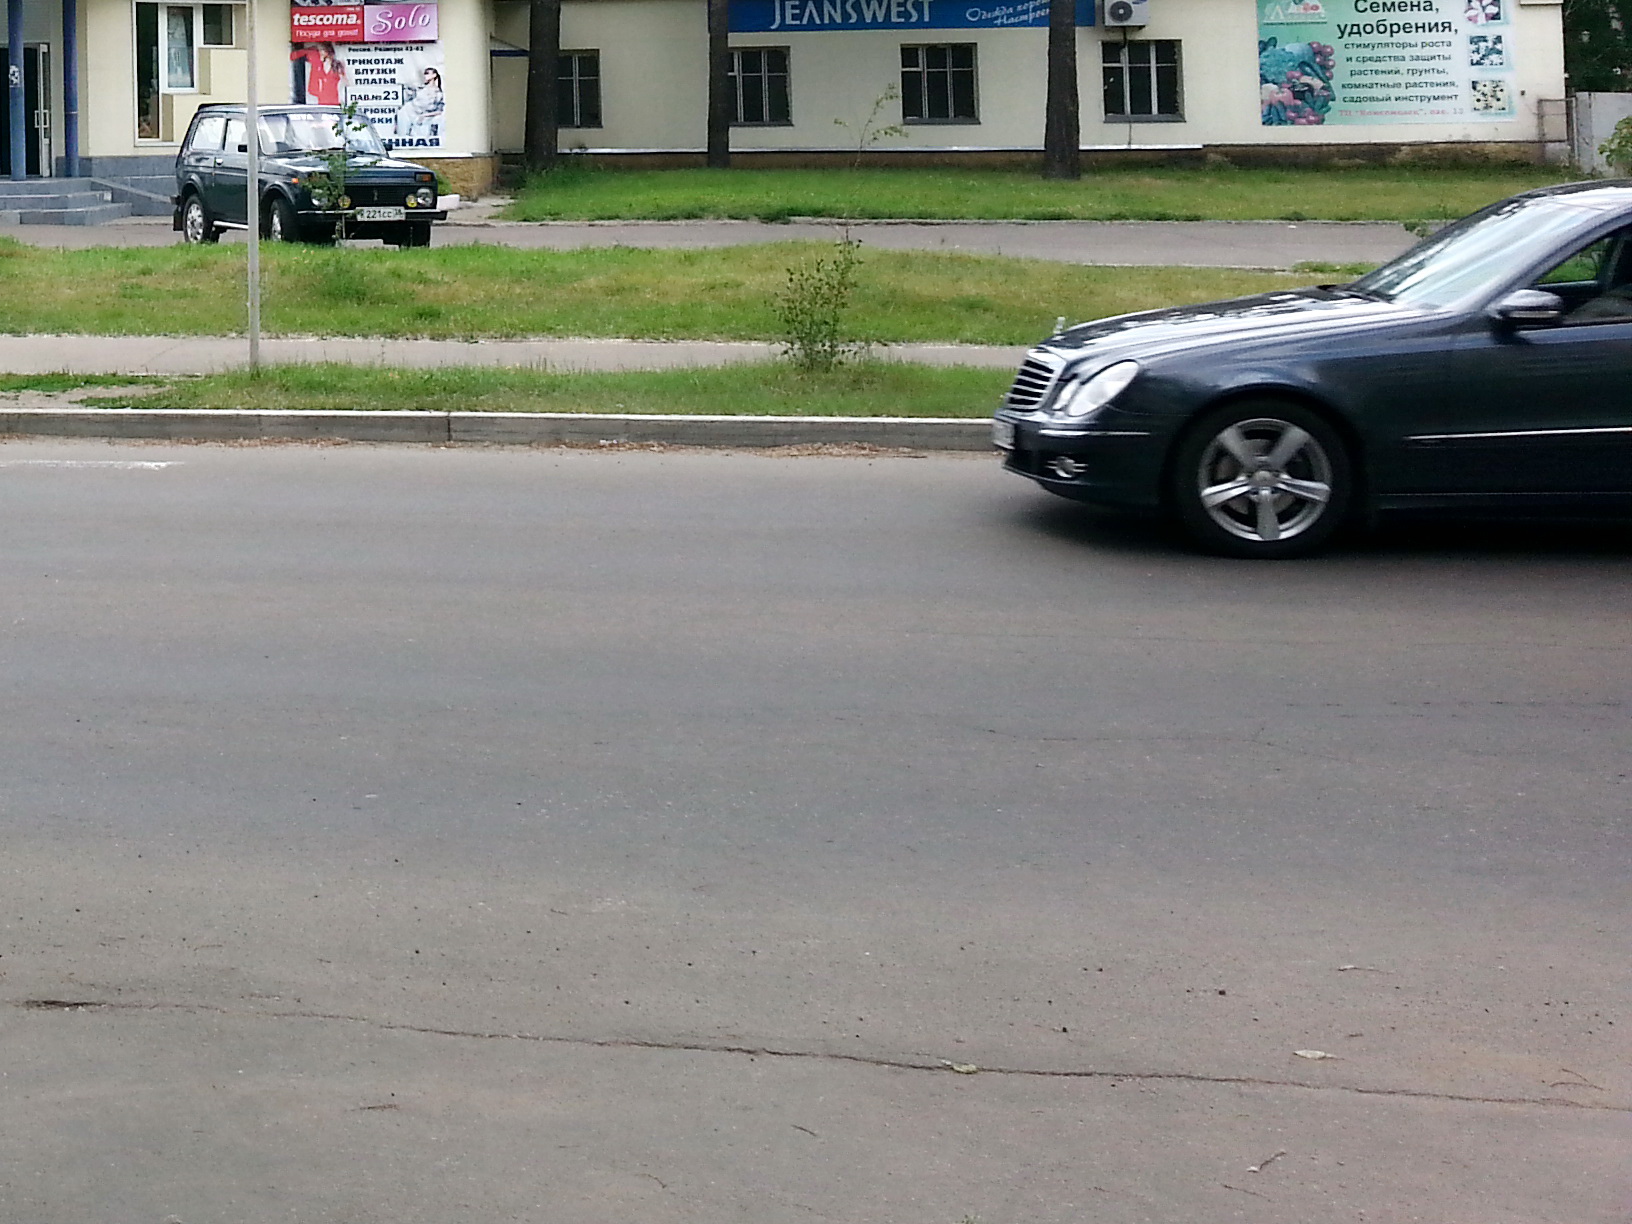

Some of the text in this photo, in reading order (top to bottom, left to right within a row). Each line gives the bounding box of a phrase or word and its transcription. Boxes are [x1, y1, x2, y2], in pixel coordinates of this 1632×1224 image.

[371, 5, 431, 36] Solo
[1336, 19, 1459, 39] удобрения,
[1344, 40, 1452, 51] стимуляторы роста
[347, 58, 404, 66] ТРИКОТАЖ
[355, 77, 396, 85] ПЛАТЬЯ
[1394, 94, 1459, 104] инструмент
